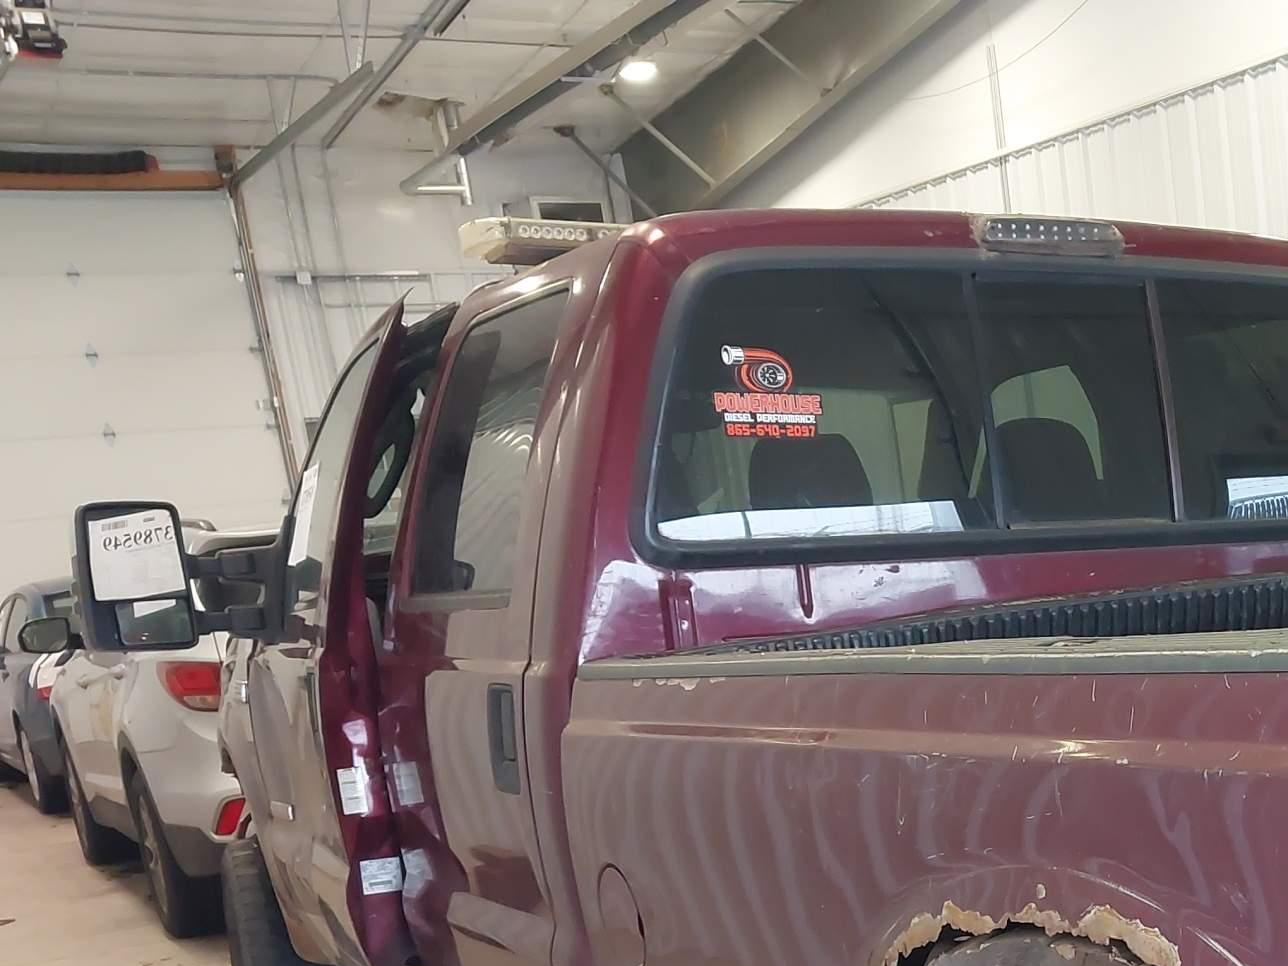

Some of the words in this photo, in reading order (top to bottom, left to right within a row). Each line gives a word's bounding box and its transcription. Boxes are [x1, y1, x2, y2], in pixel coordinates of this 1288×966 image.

[713, 392, 822, 415] POWERHOUSE
[724, 413, 754, 422] DIESEL
[756, 414, 816, 424] PERFORMANCE
